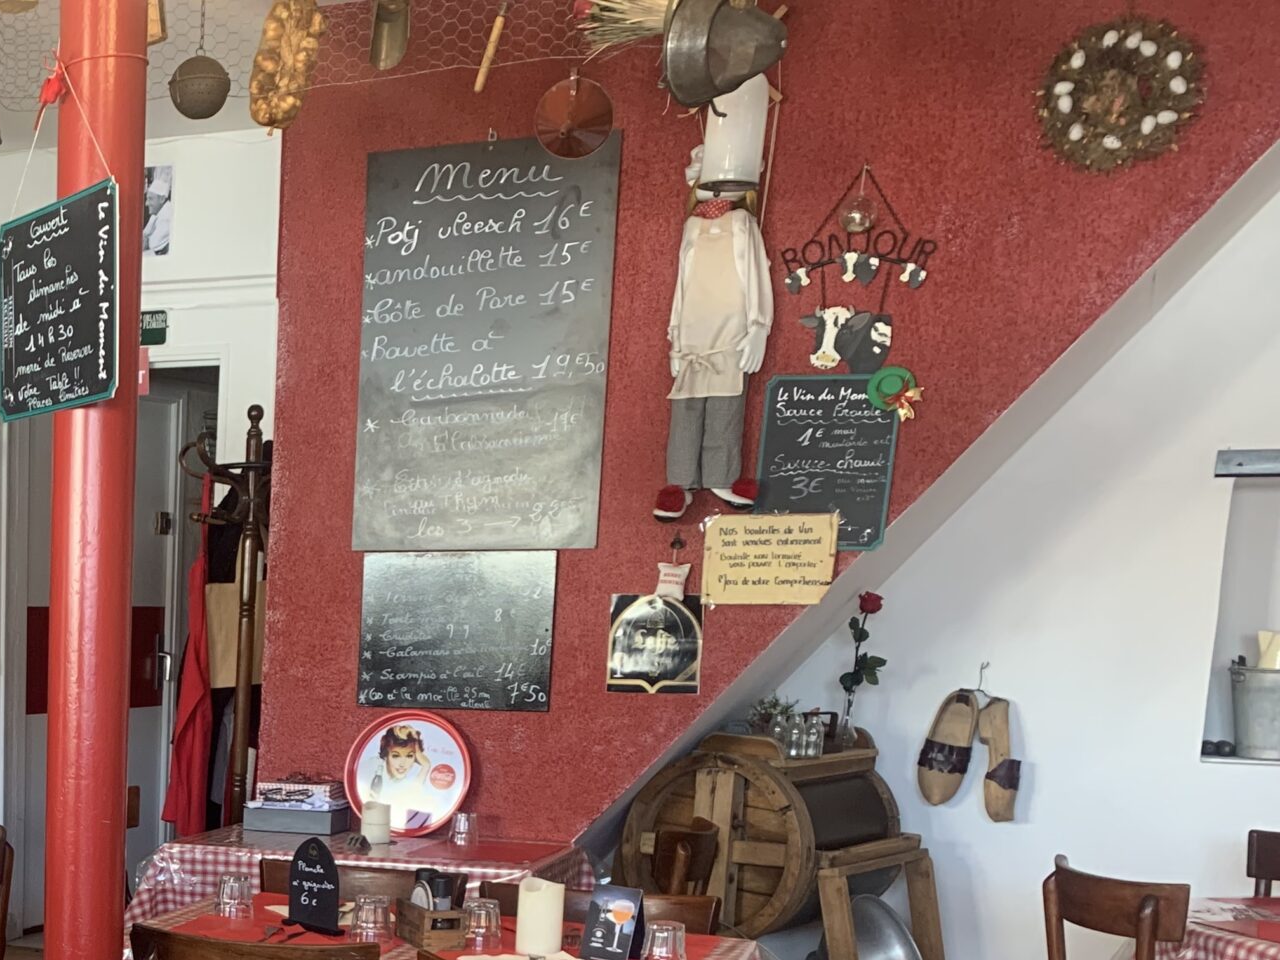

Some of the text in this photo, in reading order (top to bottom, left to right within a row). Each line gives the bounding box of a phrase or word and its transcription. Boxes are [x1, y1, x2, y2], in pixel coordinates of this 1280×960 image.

[414, 161, 564, 194] Menu
[374, 246, 527, 285] andouillette
[781, 230, 938, 274] BONJOUR
[15, 312, 31, 336] de
[37, 298, 66, 324] midi
[436, 294, 465, 318] de
[370, 333, 462, 362] Bavette
[390, 362, 523, 393] l'échalotte
[777, 386, 869, 402] Le Vin du Mom
[775, 401, 824, 418] Sauce
[380, 668, 437, 685] Scampis
